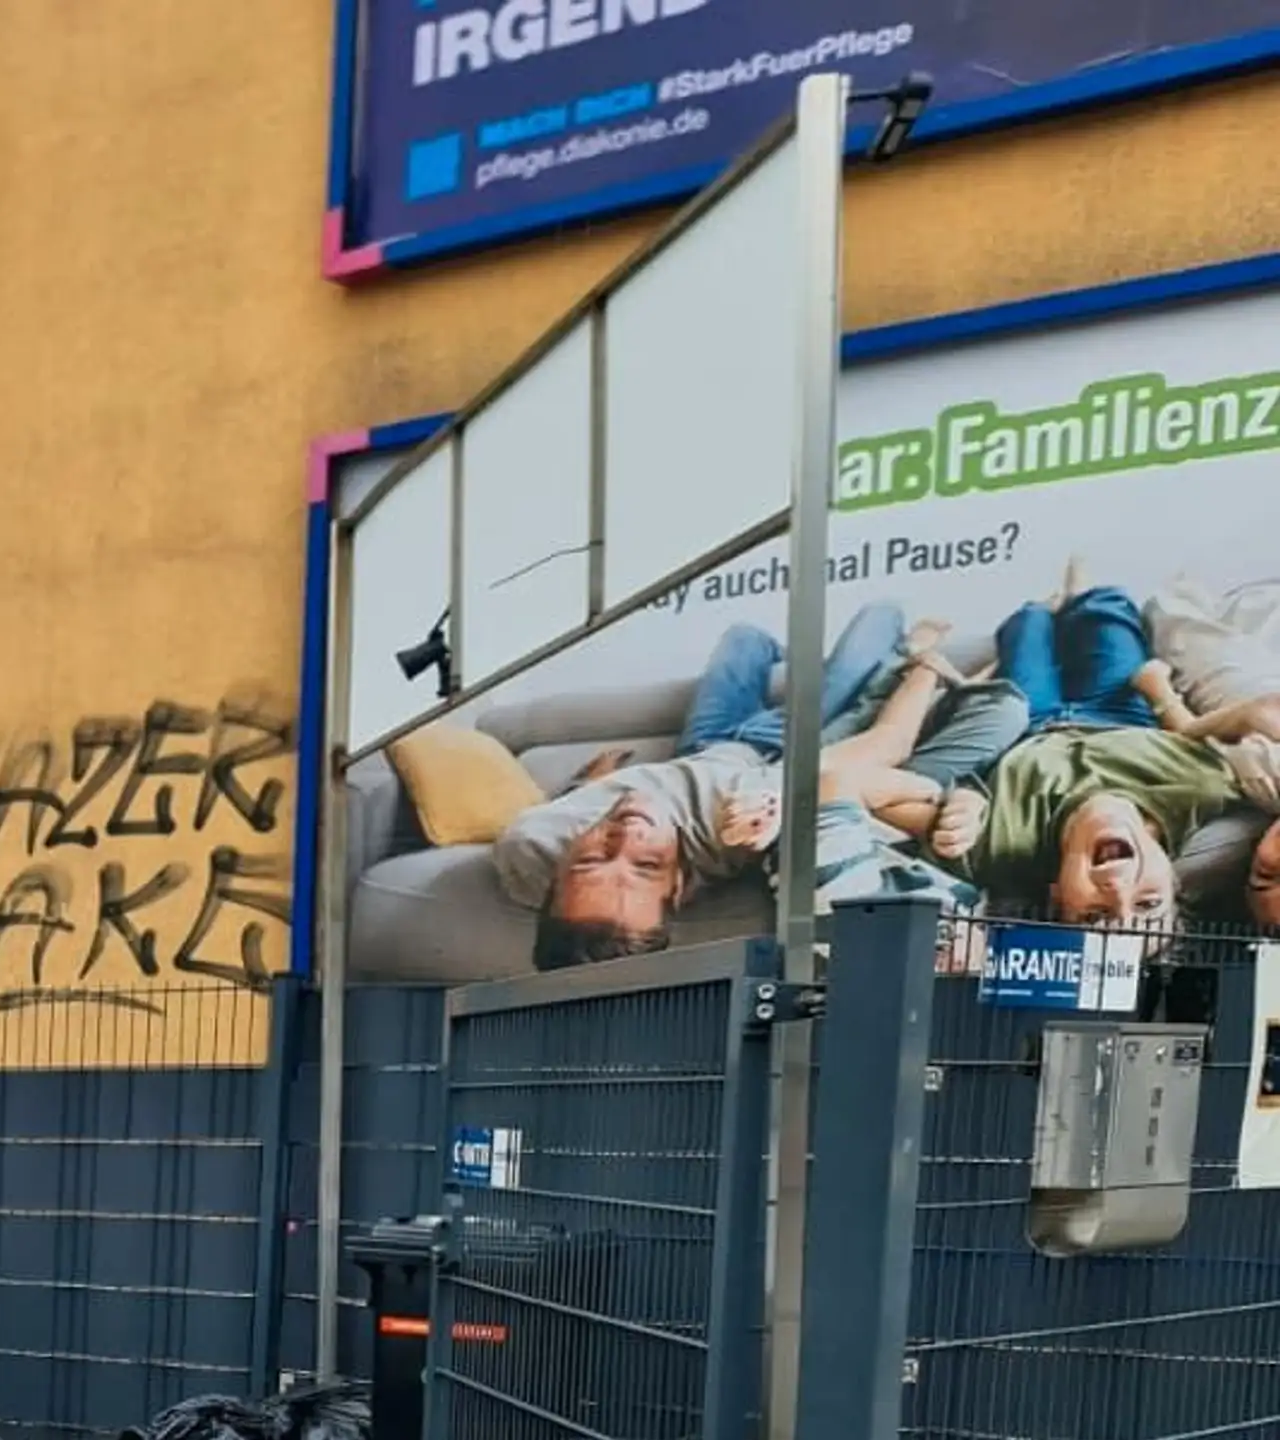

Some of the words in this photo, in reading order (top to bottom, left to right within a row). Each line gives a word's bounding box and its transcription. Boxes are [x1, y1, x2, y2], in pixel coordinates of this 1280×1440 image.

[658, 22, 914, 103] #StarkFuerPflege
[475, 108, 710, 189] pflege.diakonie.de
[886, 522, 1020, 574] Pause?
